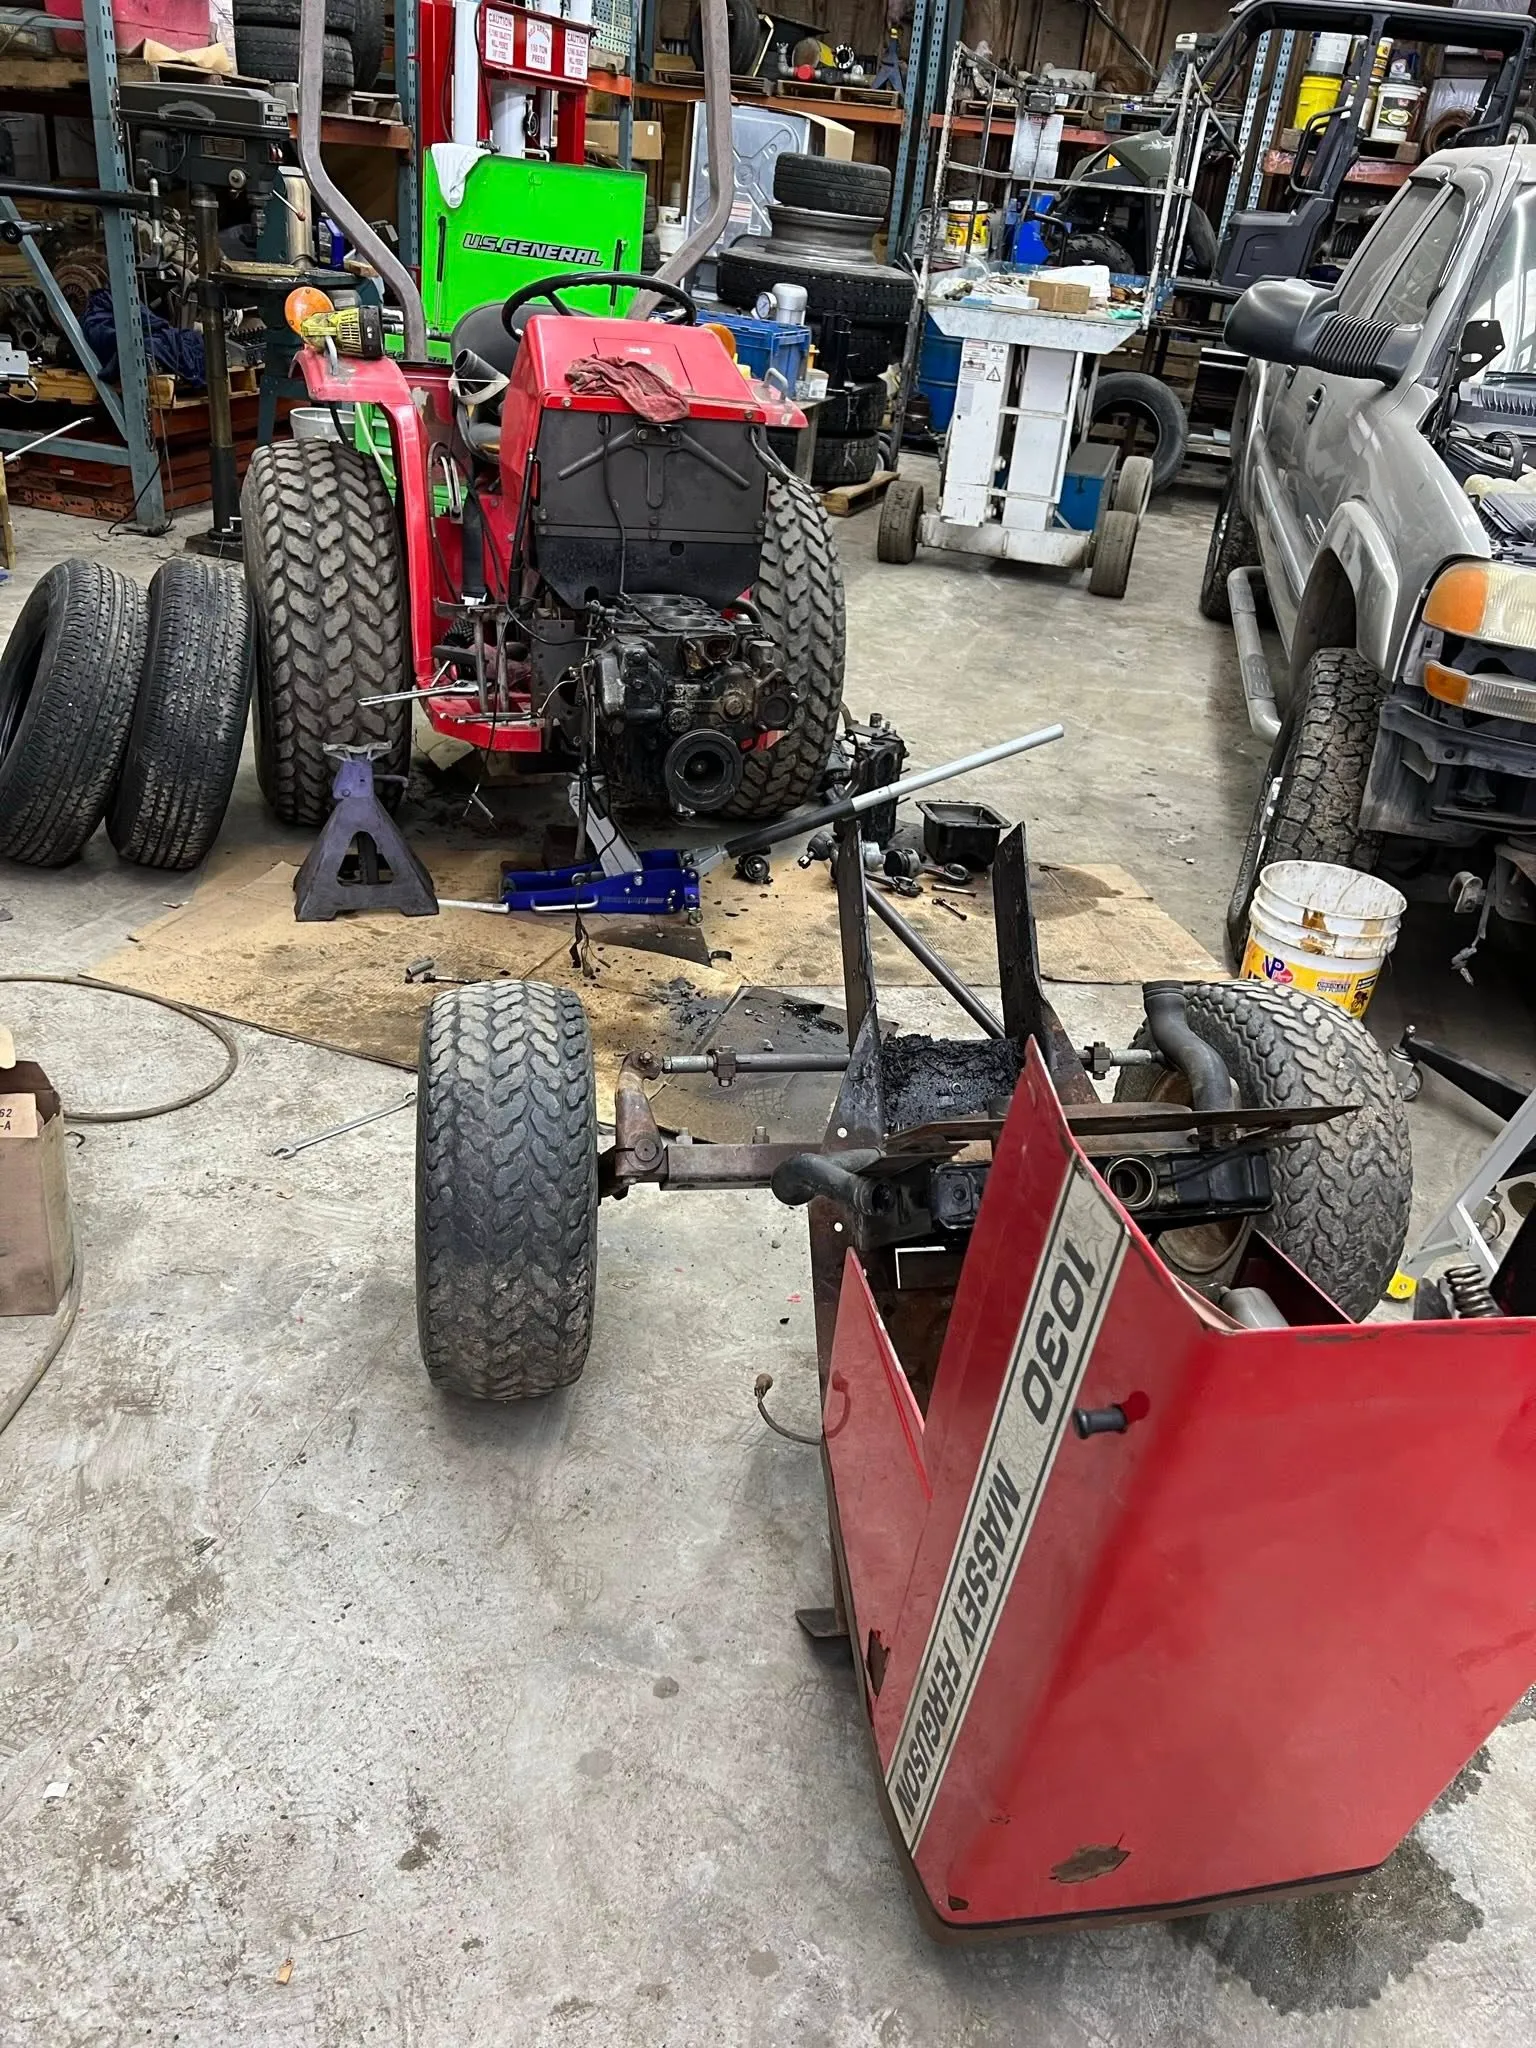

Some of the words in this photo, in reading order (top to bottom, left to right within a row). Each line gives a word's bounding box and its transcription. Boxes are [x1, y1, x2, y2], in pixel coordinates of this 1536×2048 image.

[488, 13, 512, 27] CAUTION
[566, 33, 587, 45] CAUTION
[531, 54, 546, 64] PRESS
[538, 45, 548, 55] TON
[1264, 955, 1285, 980] VP
[1021, 1239, 1096, 1425] 1030
[953, 1458, 1022, 1657] MASSEY
[894, 1636, 963, 1828] FERGUSON
